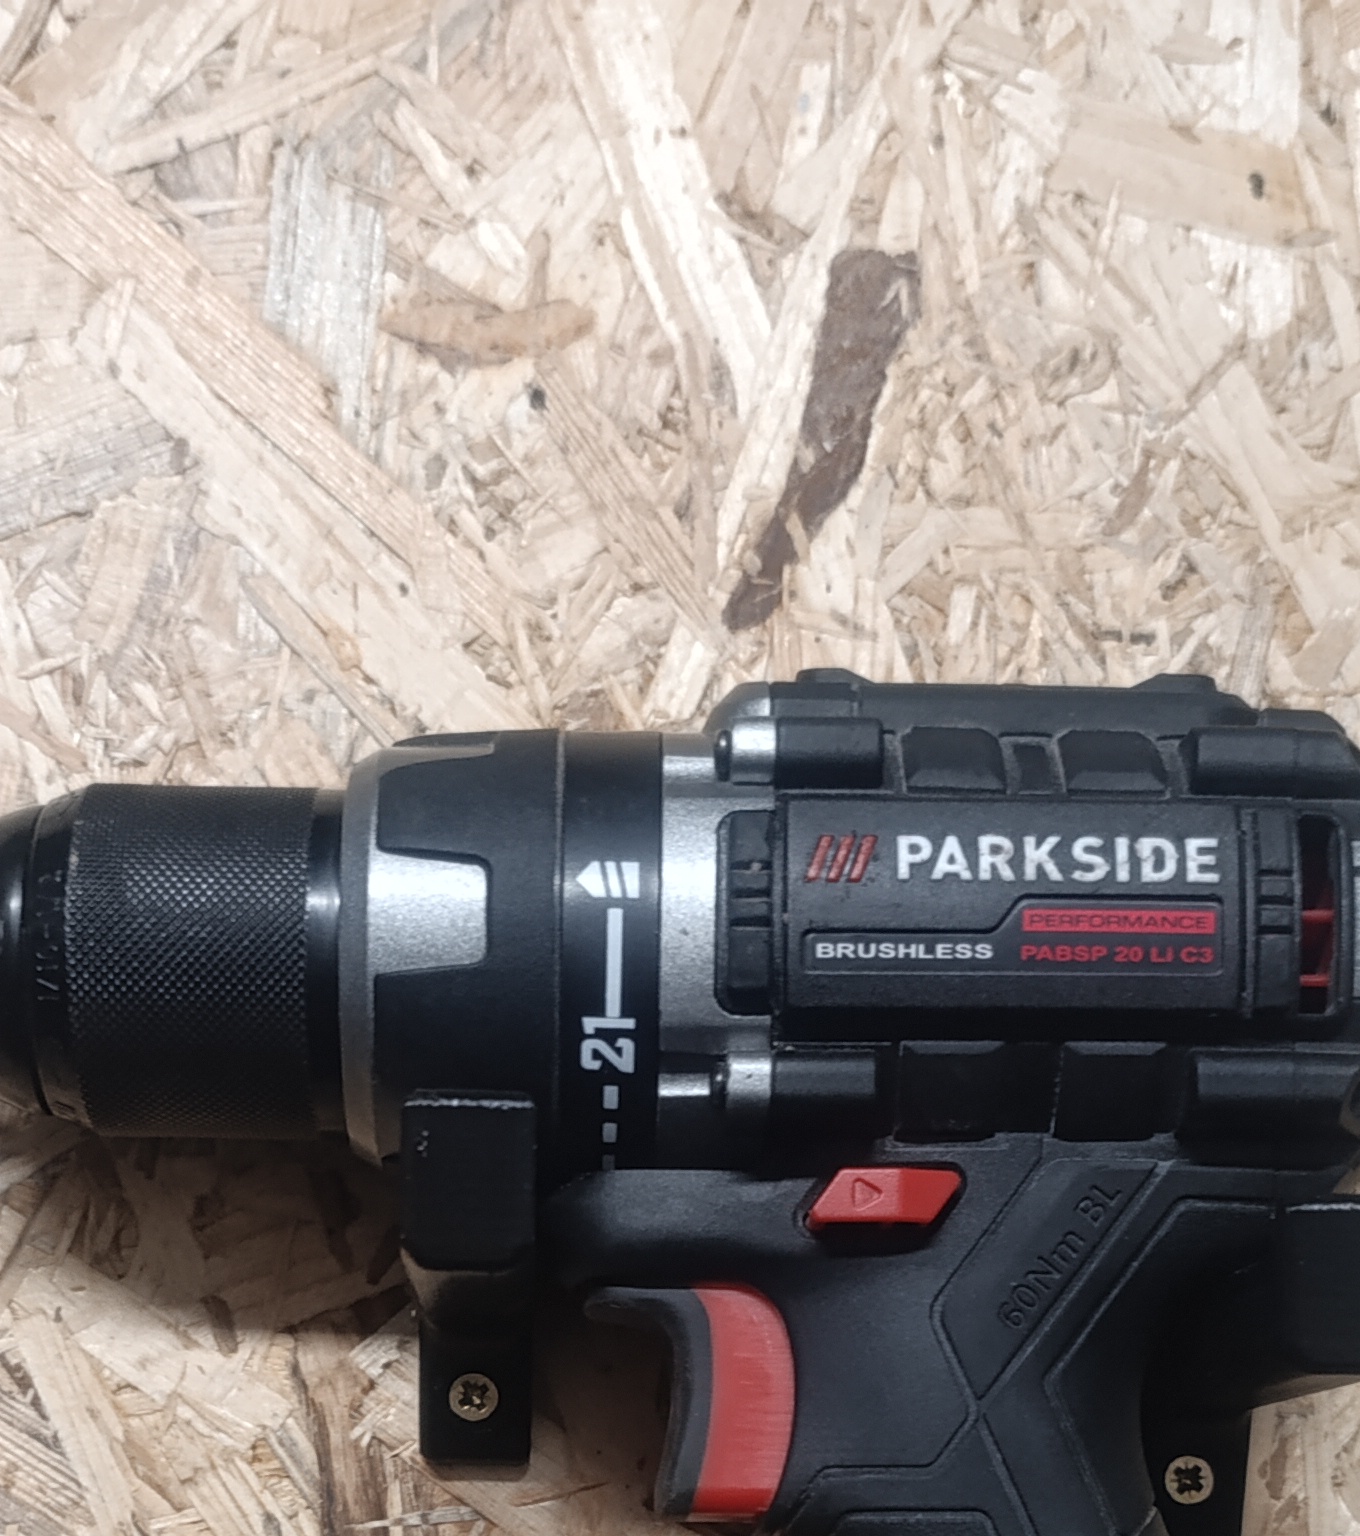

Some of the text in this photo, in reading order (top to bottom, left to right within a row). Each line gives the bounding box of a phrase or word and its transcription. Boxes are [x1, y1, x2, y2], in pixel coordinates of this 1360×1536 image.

[896, 835, 1221, 883] PARKSIDE
[1028, 911, 1210, 931] PERFORMANCE
[815, 943, 994, 960] BRUSHLESS
[1020, 945, 1108, 962] PABSP
[1114, 946, 1143, 963] 20
[1180, 947, 1214, 964] C3
[580, 1016, 636, 1074] 21
[997, 1184, 1122, 1328] 60Nm BL
